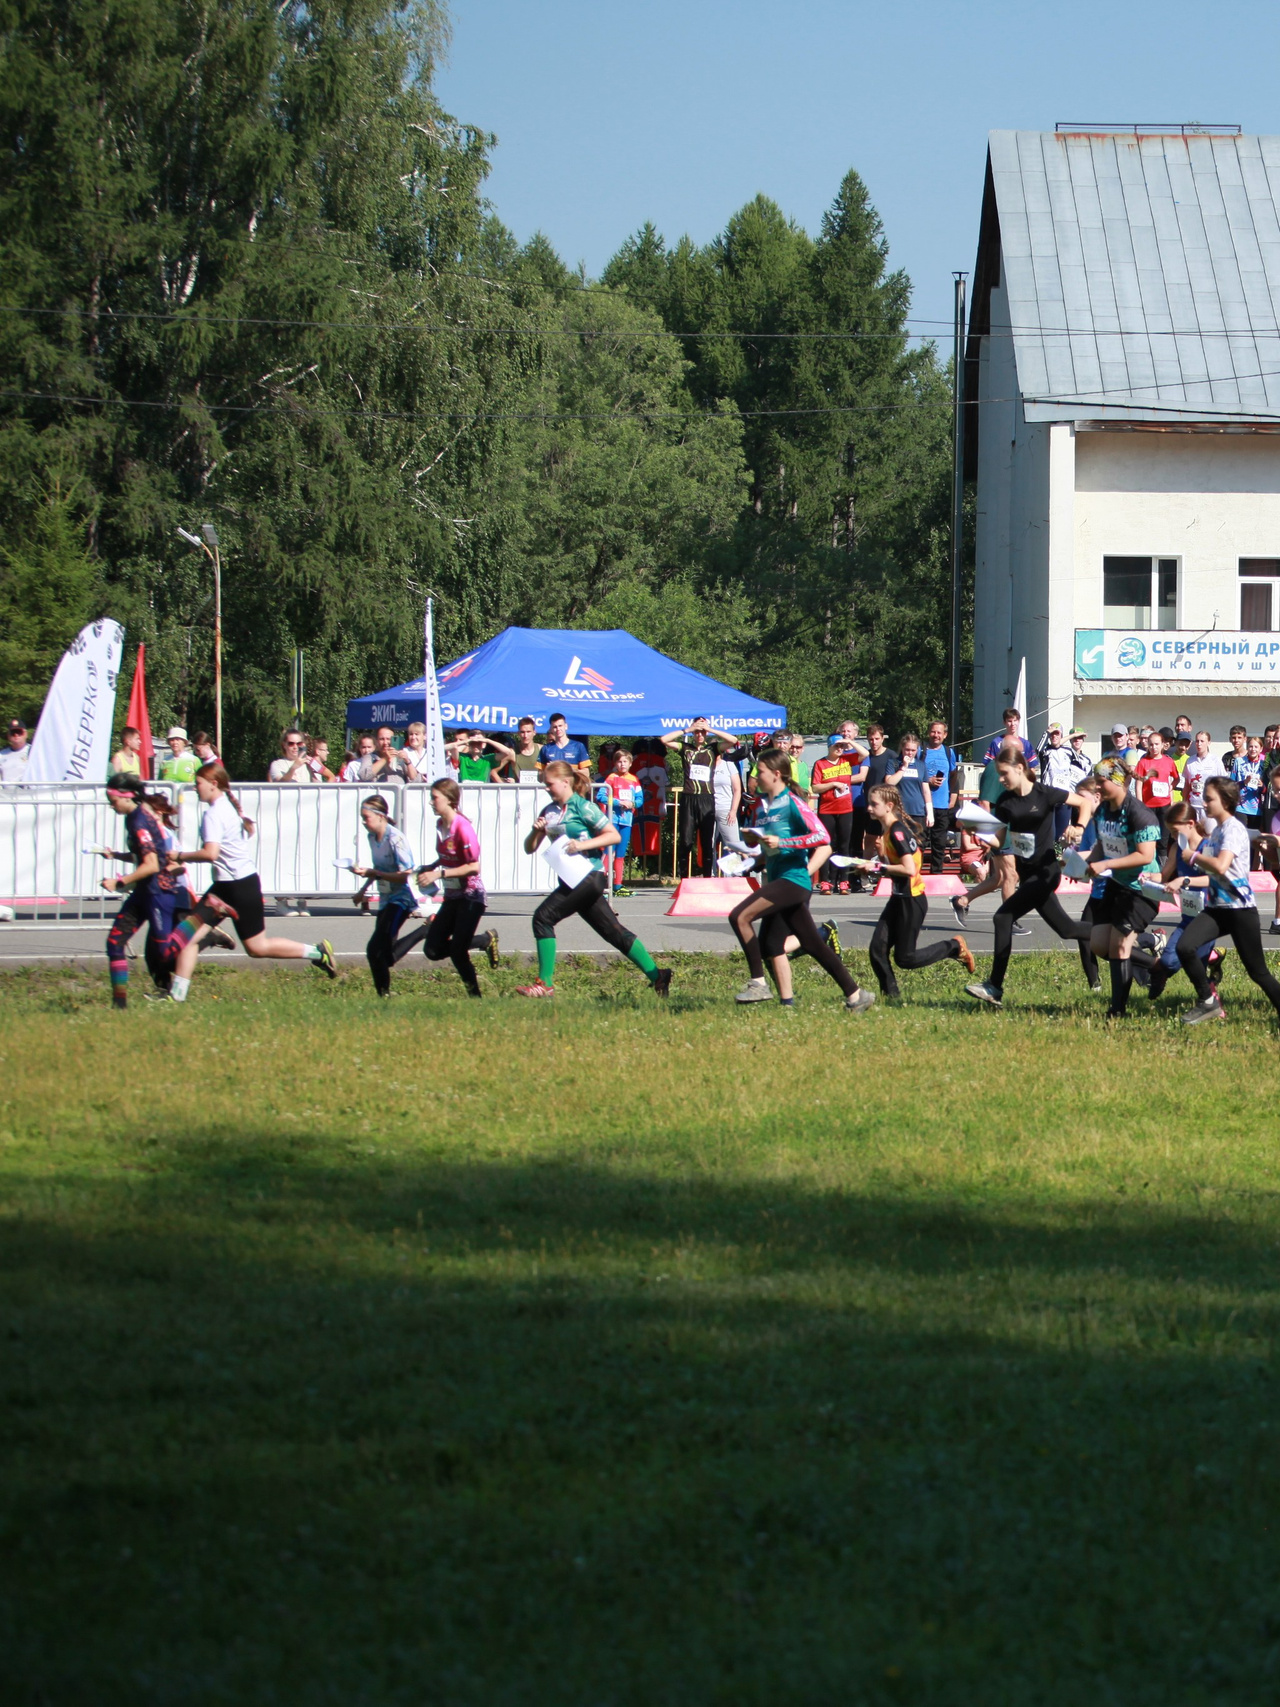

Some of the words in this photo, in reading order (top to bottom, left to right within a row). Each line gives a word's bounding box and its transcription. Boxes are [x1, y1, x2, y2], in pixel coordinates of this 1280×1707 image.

[1152, 639, 1249, 655] СЕВЕРНЫЙ
[1152, 660, 1221, 670] ШКОЛА
[1237, 661, 1277, 671] УШУ
